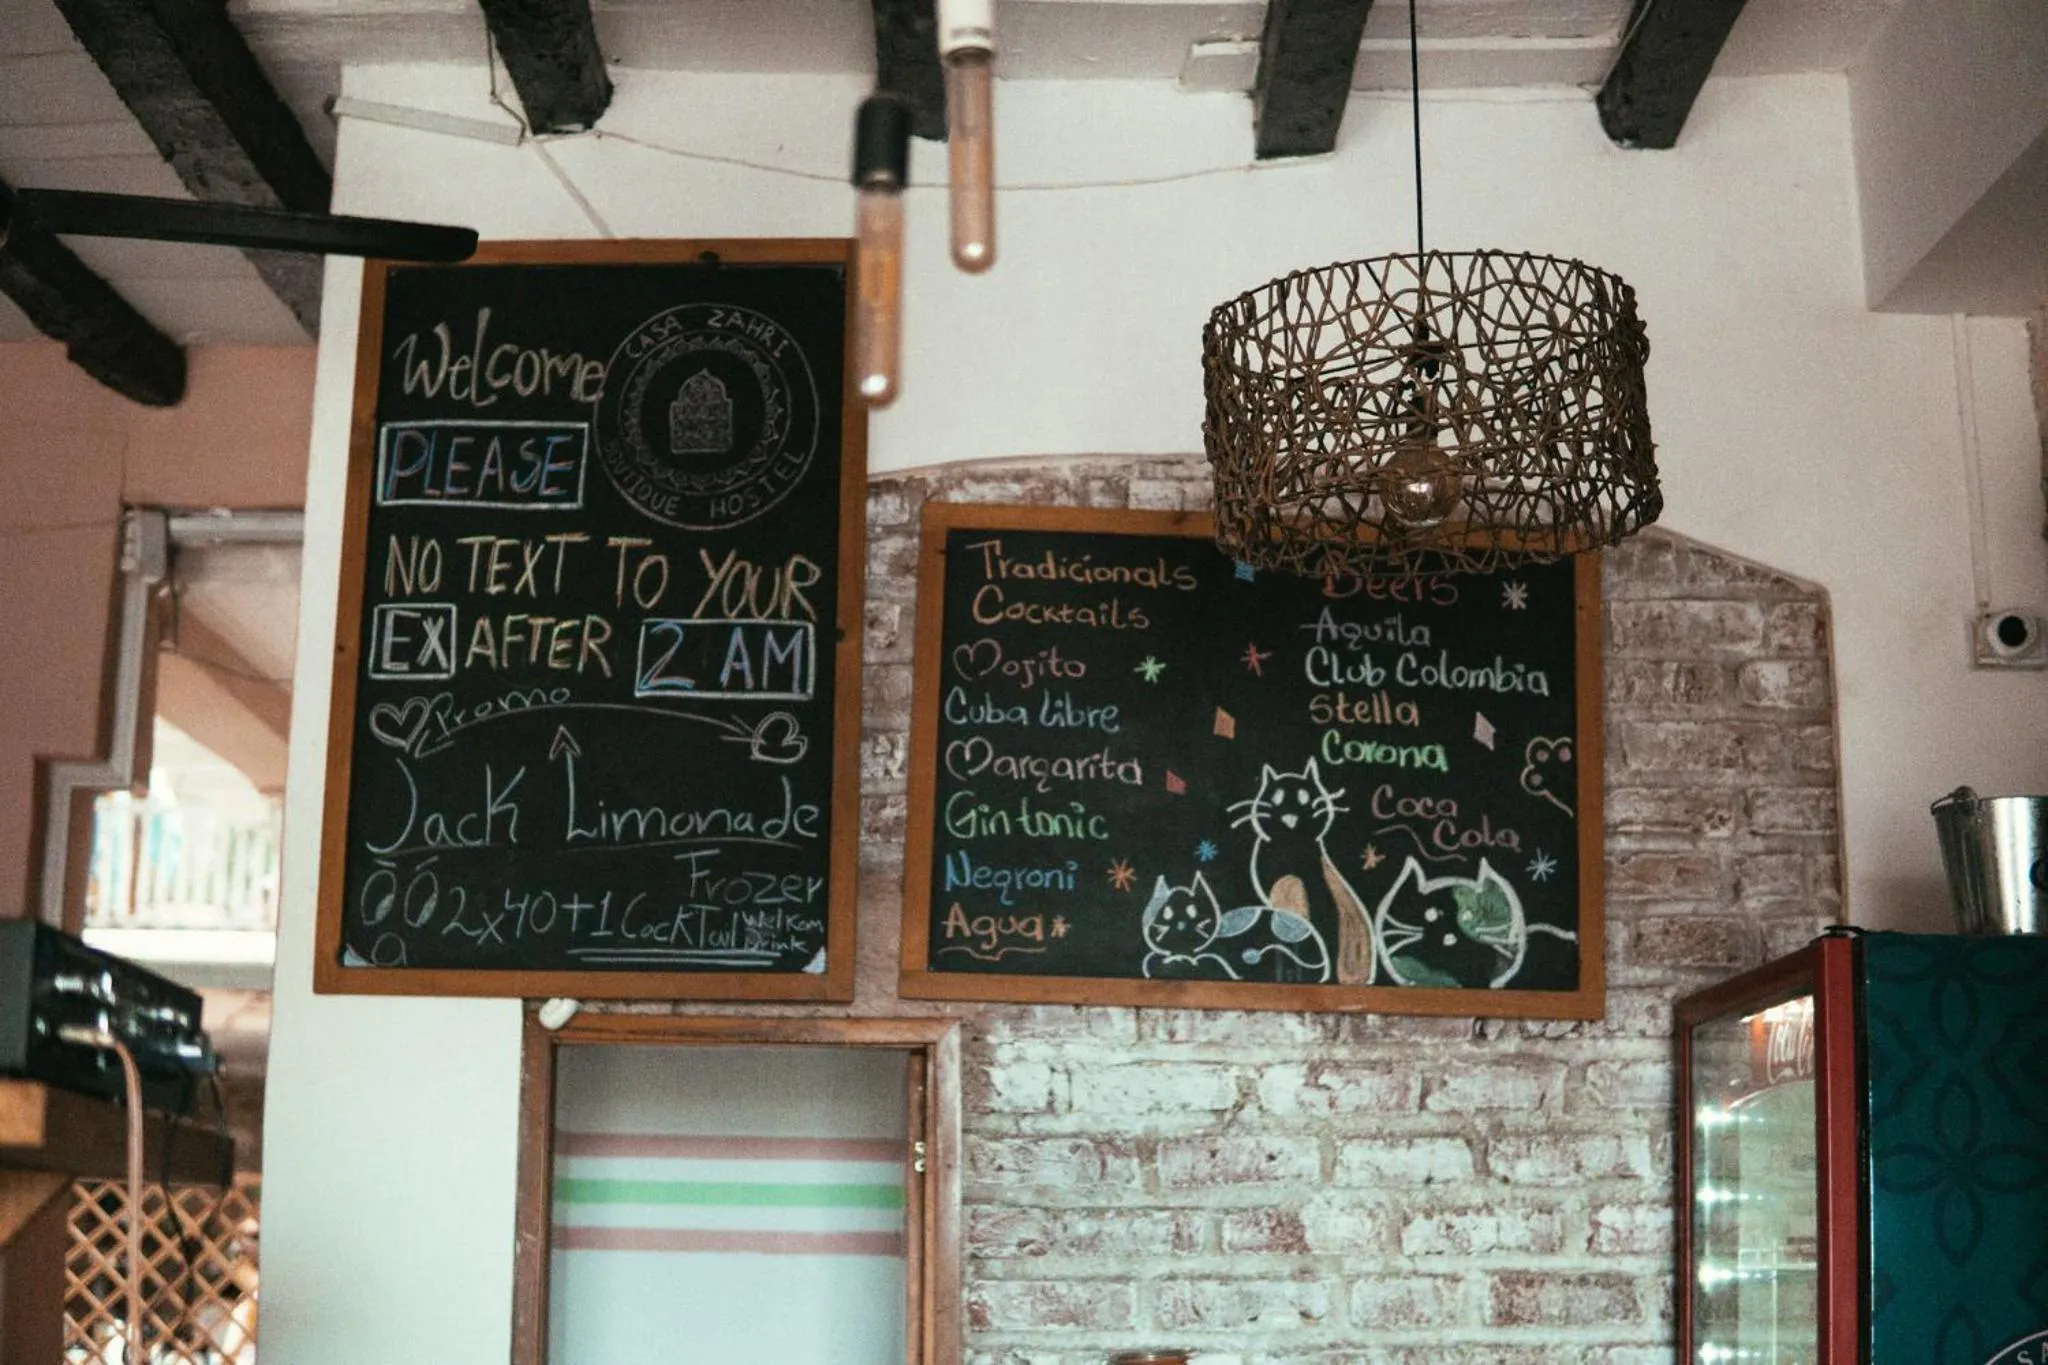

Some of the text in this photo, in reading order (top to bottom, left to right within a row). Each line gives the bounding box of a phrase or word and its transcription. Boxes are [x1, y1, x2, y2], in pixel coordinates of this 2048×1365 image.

[393, 307, 605, 406] Welcome
[626, 308, 790, 360] CASA ZAHRI
[386, 430, 576, 500] PLEASE
[709, 451, 805, 519] HOSTEL
[383, 532, 822, 622] NO TEXT TO YOUR
[965, 539, 1198, 591] Tradicionals
[972, 584, 1150, 629] Cocktails
[381, 610, 804, 693] EX AFTER 2 AM
[953, 638, 1087, 689] Mojito
[1304, 646, 1550, 697] Club Colombia
[433, 688, 571, 738] Promo
[945, 686, 1120, 732] Cuba Libre
[1308, 690, 1420, 729] Stella
[945, 737, 1143, 793] Margarita
[1321, 728, 1450, 773] Corona
[565, 750, 820, 843] Limonade
[945, 790, 1110, 840] Gin tonic
[1371, 784, 1459, 820] Coca
[1432, 815, 1521, 853] Cola
[944, 850, 1079, 906] Negroni
[942, 902, 1045, 950] Agua
